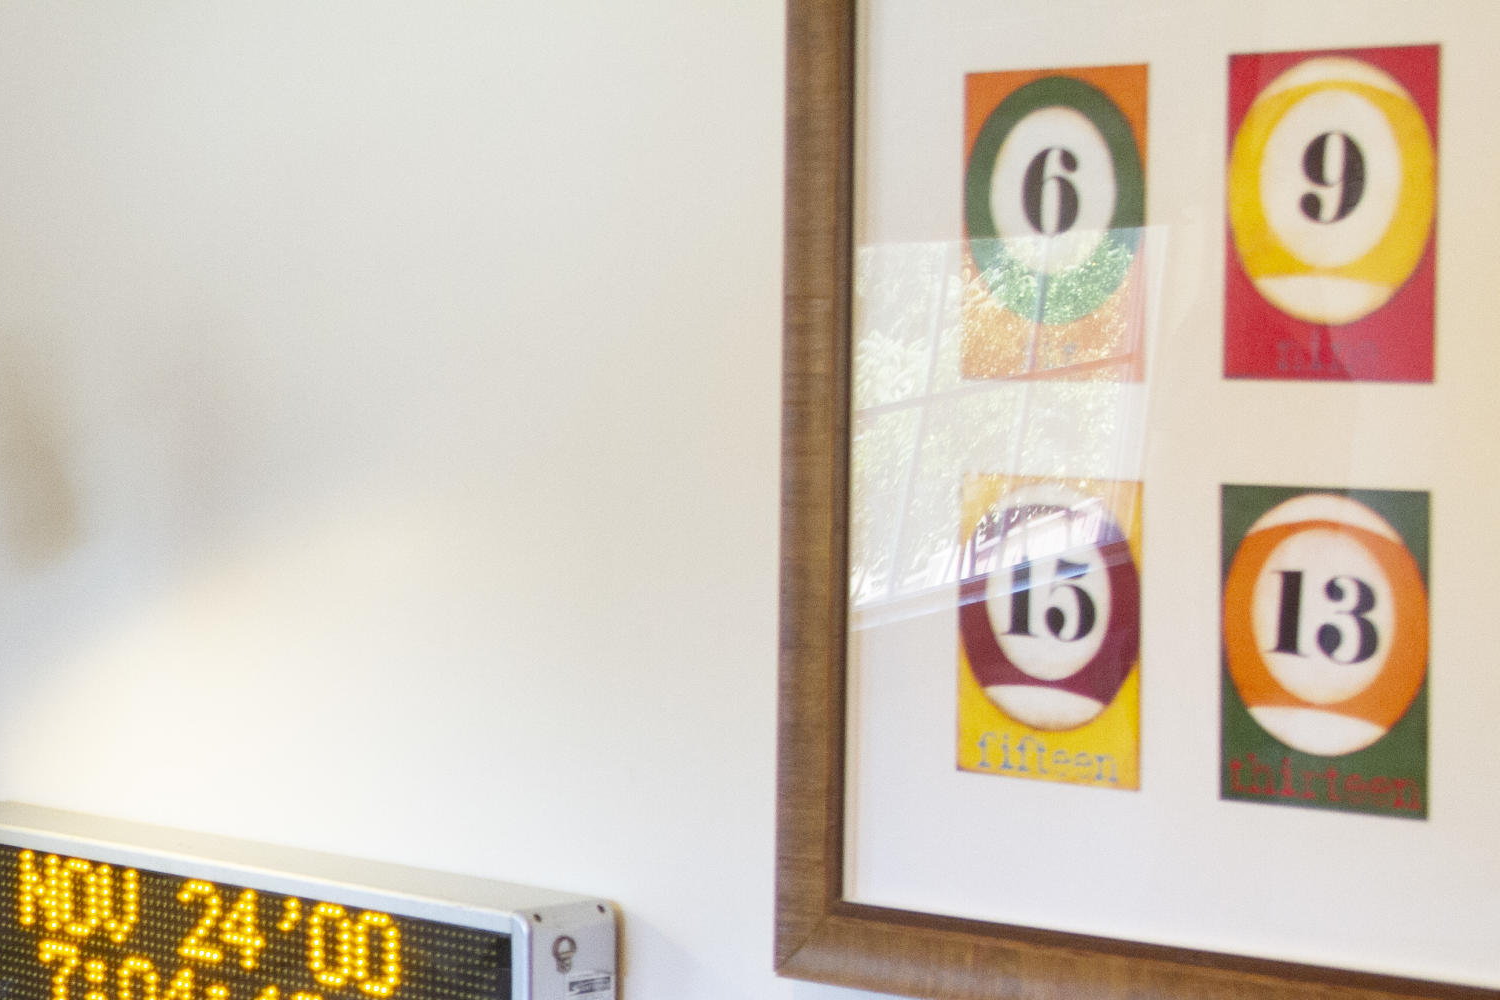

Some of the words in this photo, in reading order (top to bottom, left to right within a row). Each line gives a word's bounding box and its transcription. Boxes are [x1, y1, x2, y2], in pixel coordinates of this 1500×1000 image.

[1021, 146, 1080, 236] 6
[1298, 131, 1367, 225] 9
[1000, 553, 1097, 642] 15
[1267, 569, 1380, 665] 13
[976, 731, 1120, 783] fifteen
[1228, 752, 1422, 812] thirteen
[18, 848, 141, 944] NOV
[177, 877, 268, 971] 24
